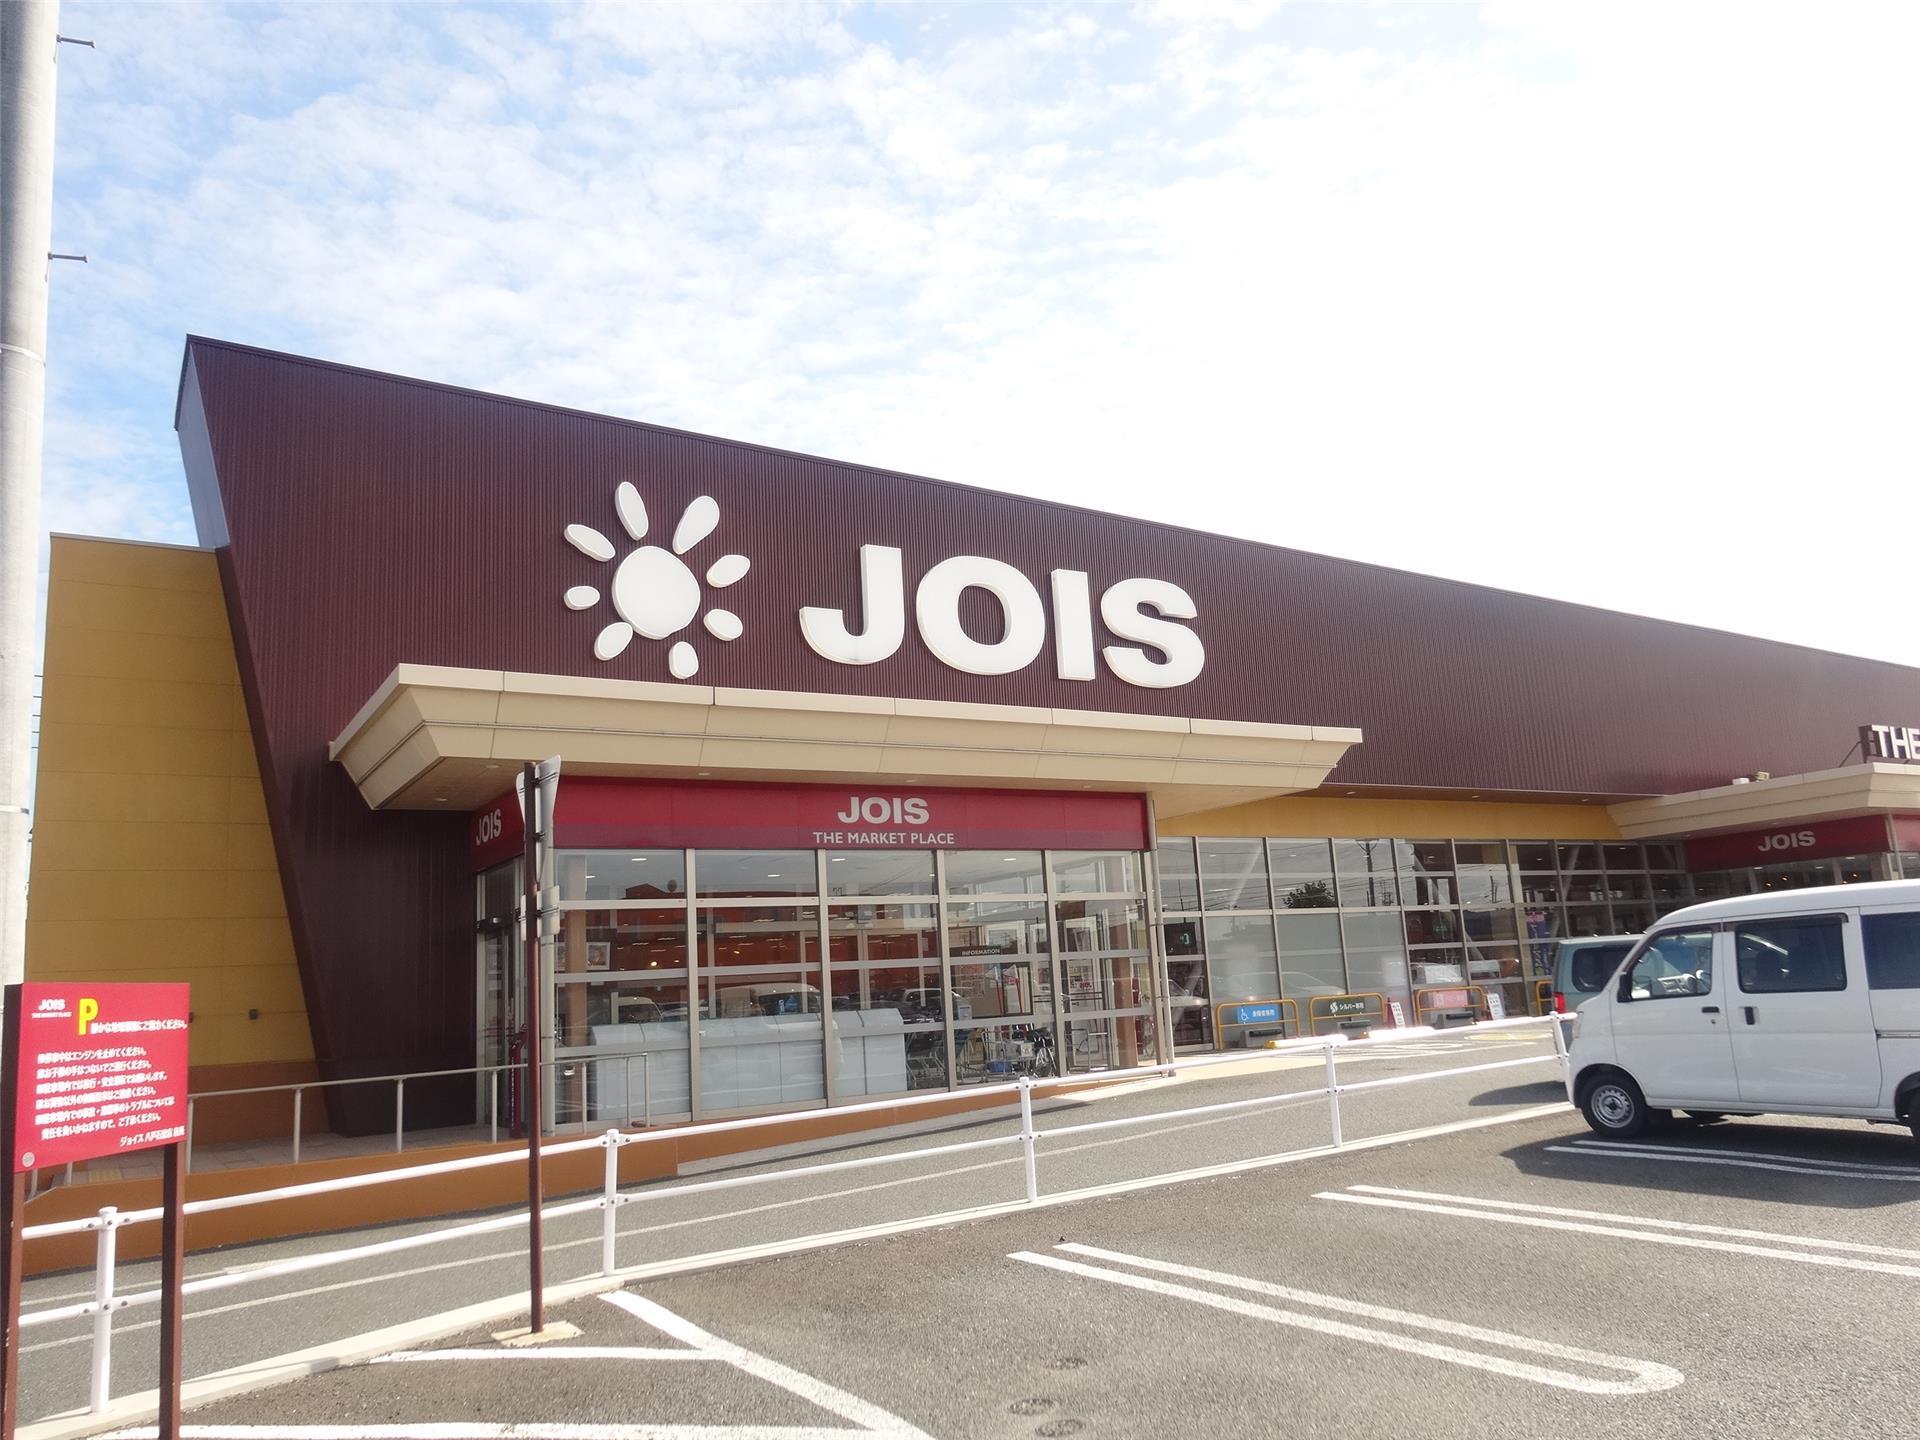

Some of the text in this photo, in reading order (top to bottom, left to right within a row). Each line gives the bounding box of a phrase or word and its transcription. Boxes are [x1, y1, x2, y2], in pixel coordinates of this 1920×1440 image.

[799, 544, 1205, 688] JOIS
[1871, 724, 1920, 759] THE
[838, 796, 930, 825] JOIS
[476, 808, 502, 846] JOIS
[813, 831, 955, 845] THE MARKET PLACE
[1758, 830, 1816, 851] JOIS
[962, 948, 1001, 956] INFORMATION
[39, 999, 65, 1010] JOIS
[79, 998, 98, 1035] P
[120, 1133, 145, 1147] ジョイス
